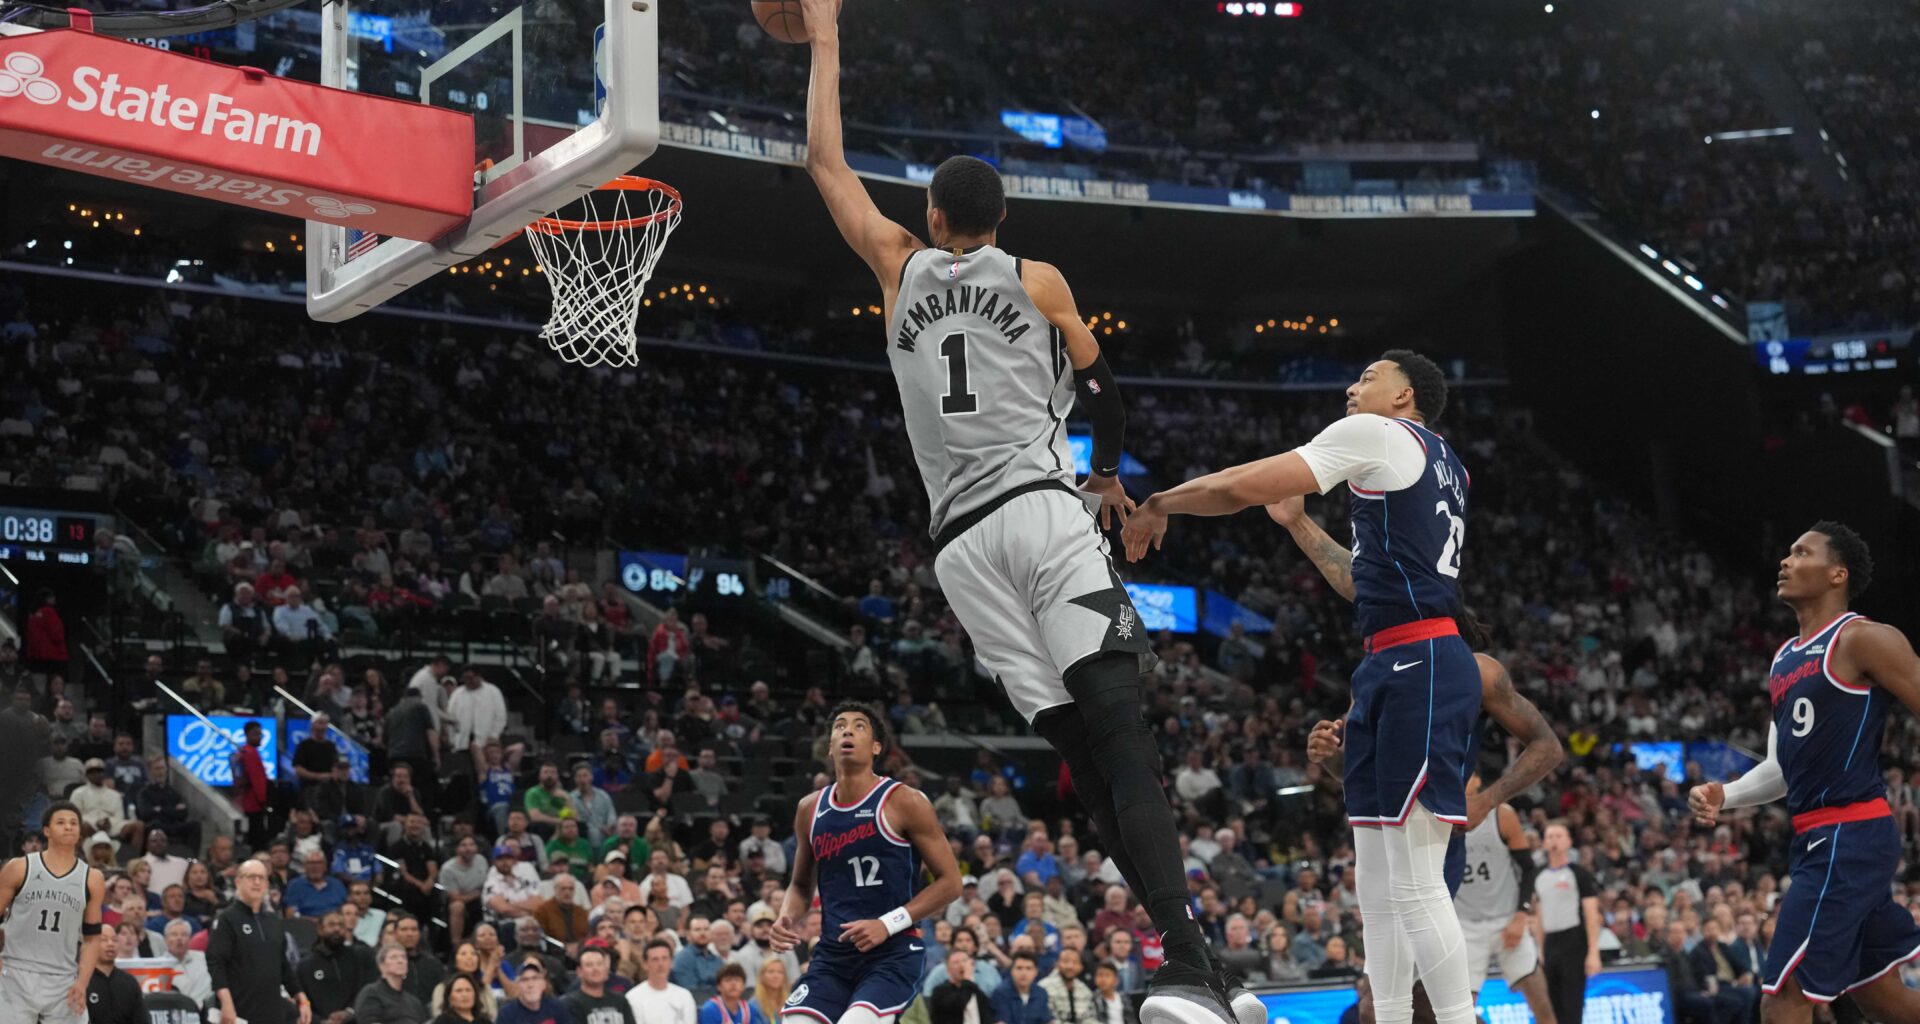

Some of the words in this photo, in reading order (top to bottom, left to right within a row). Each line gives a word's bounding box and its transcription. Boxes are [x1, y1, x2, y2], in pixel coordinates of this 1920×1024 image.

[897, 286, 1031, 353] WEMBANYAMA
[938, 331, 980, 416] 1
[716, 573, 744, 596] 94
[1791, 697, 1815, 738] 9
[813, 820, 877, 862] Clippers
[848, 855, 883, 887] 12
[1463, 861, 1490, 884] 24
[25, 890, 42, 905] SAN
[45, 889, 81, 912] ANTONIO
[38, 909, 61, 933] 11
